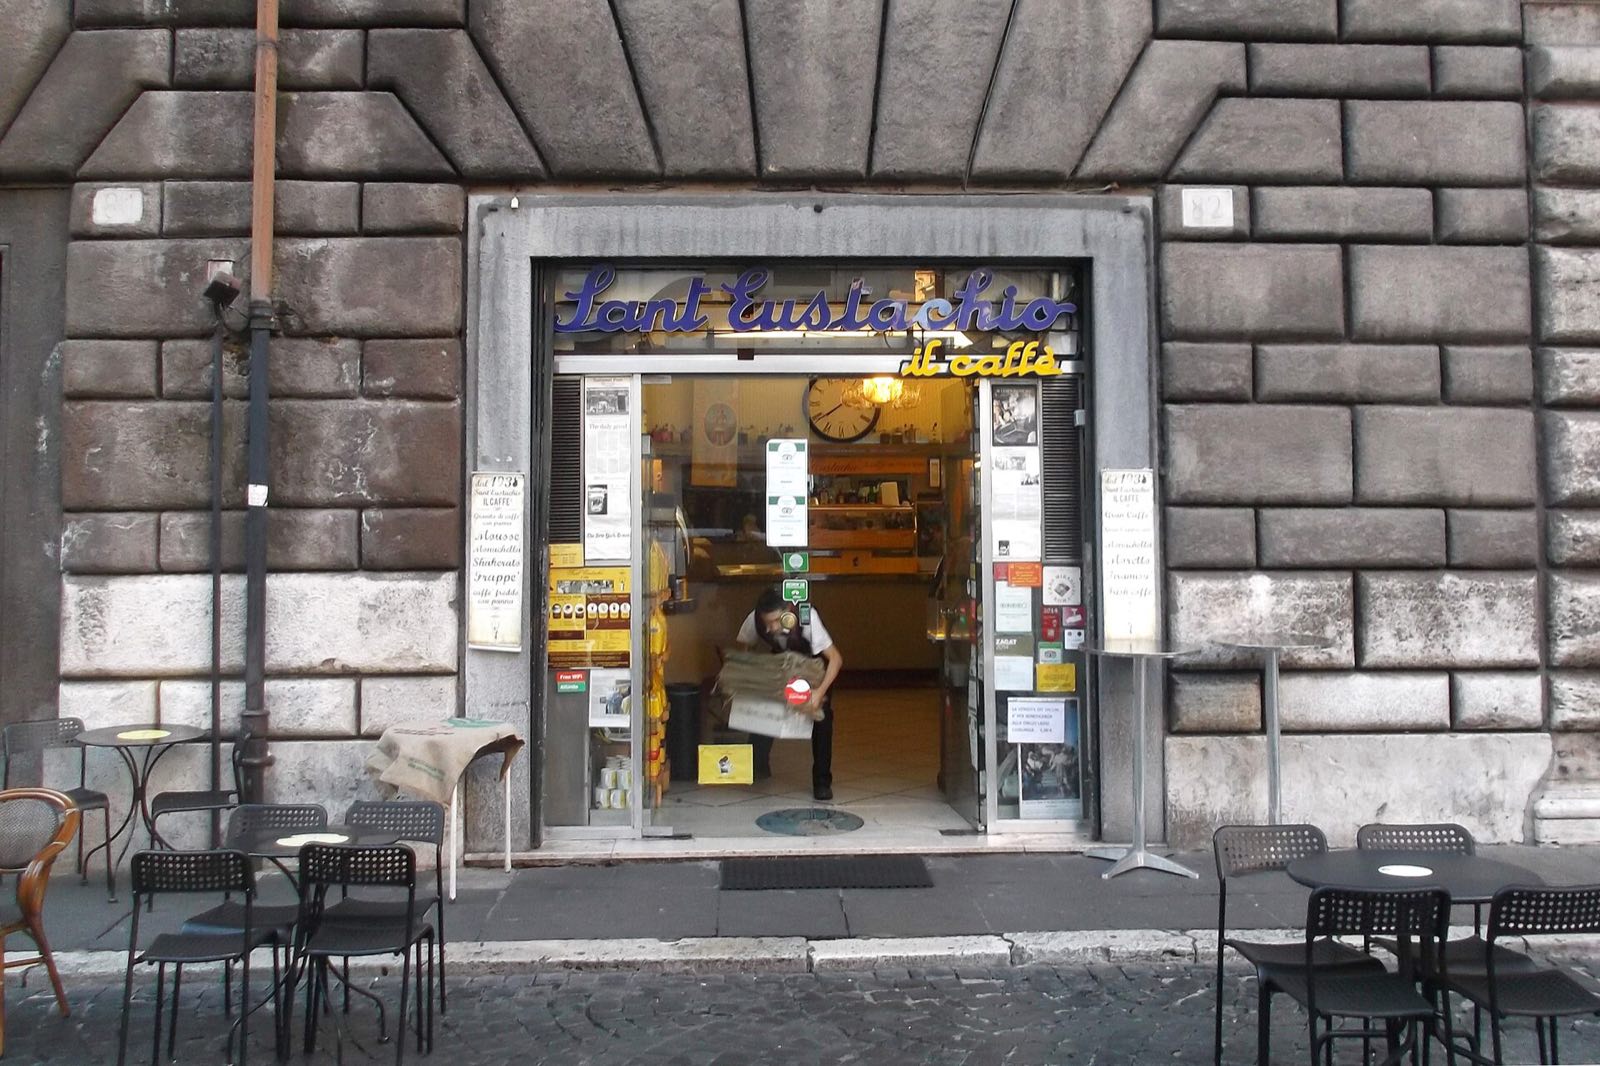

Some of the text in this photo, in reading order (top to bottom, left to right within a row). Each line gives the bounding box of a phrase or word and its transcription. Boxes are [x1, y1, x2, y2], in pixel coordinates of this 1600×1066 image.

[721, 266, 1077, 332] Eustachio
[900, 339, 942, 377] il
[475, 529, 520, 541] Mousse
[473, 557, 520, 567] Shakerato
